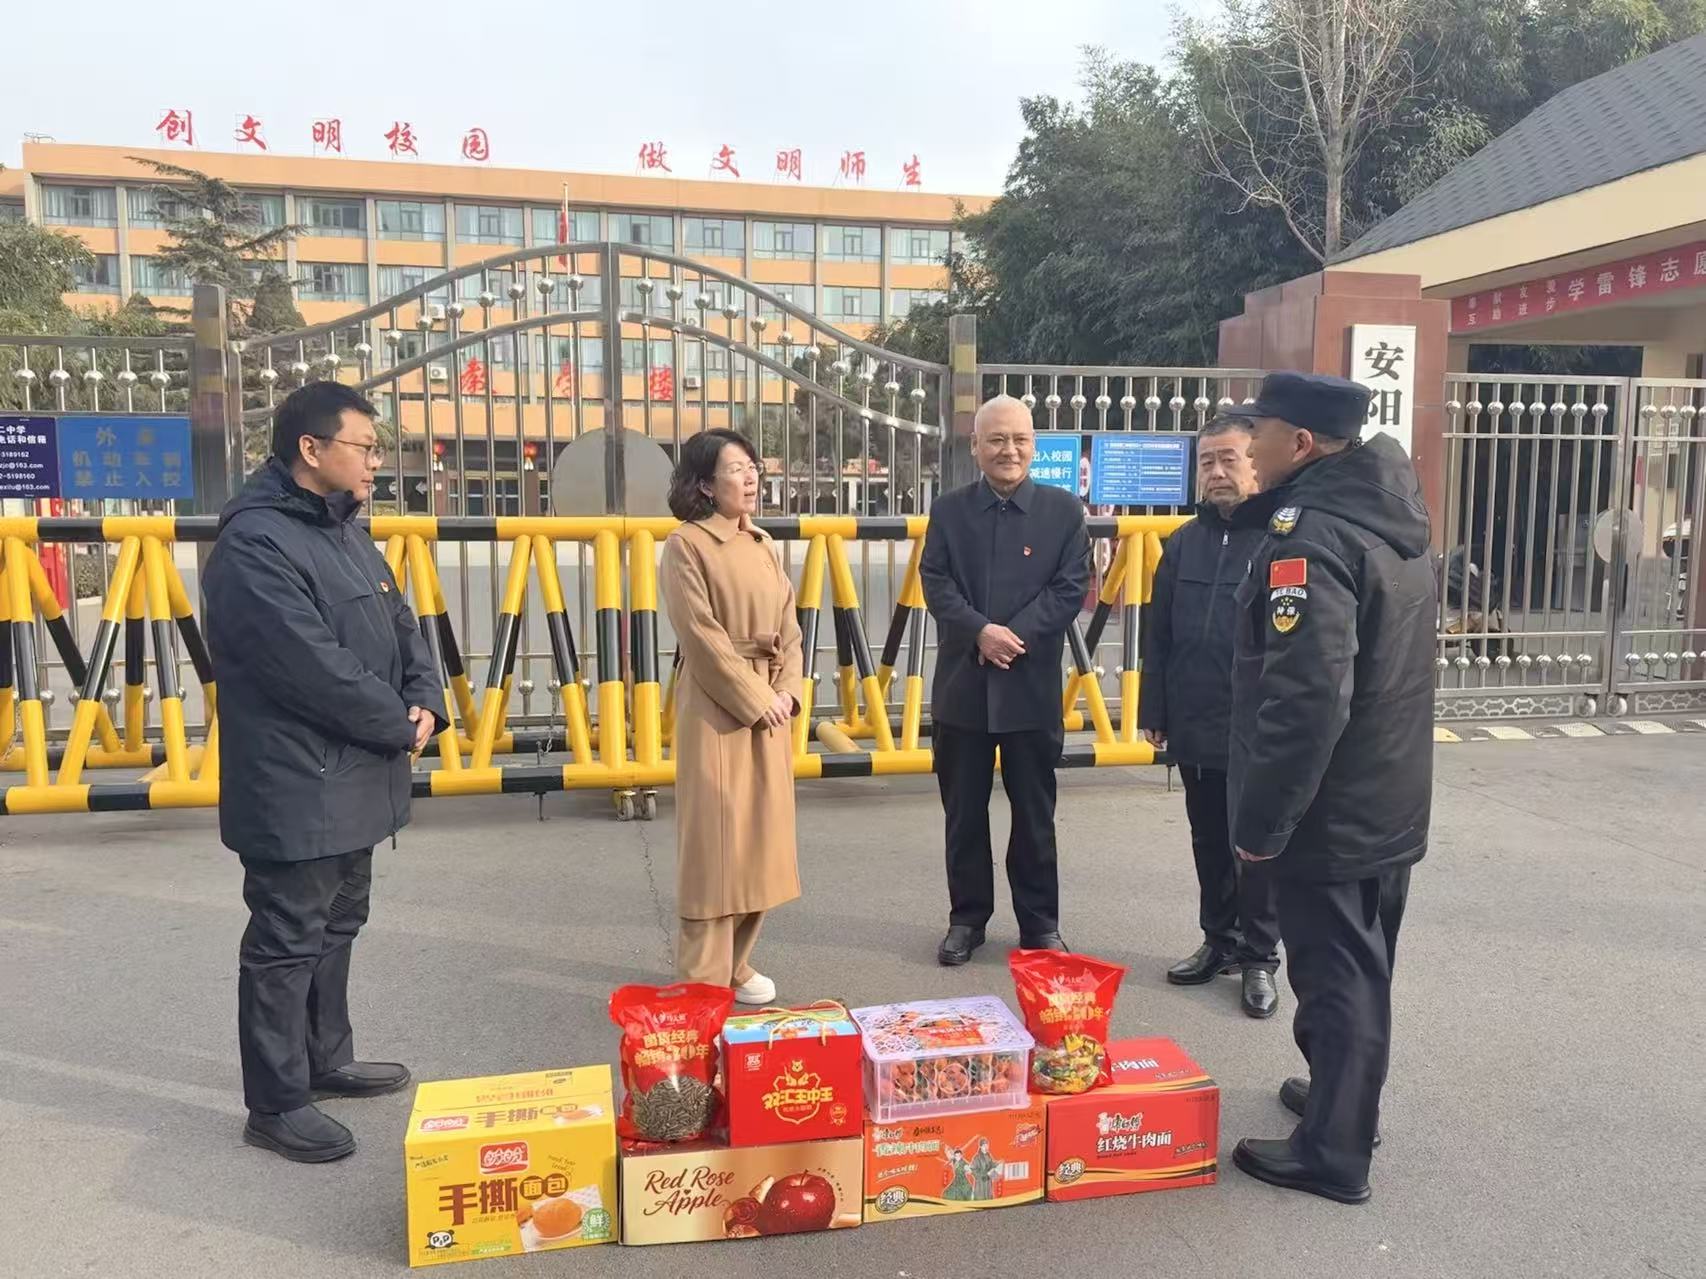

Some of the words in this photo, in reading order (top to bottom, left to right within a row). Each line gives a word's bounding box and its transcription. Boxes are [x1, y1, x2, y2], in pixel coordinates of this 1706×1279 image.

[156, 109, 491, 161] 创文明校园
[639, 142, 922, 186] 做文明师生
[1364, 341, 1404, 425] 安阳
[1097, 1130, 1172, 1152] 红烧牛肉面
[644, 1168, 688, 1192] Red
[692, 1166, 735, 1191] Rose
[439, 1177, 567, 1226] 手撕面包
[643, 1188, 723, 1216] Apple
